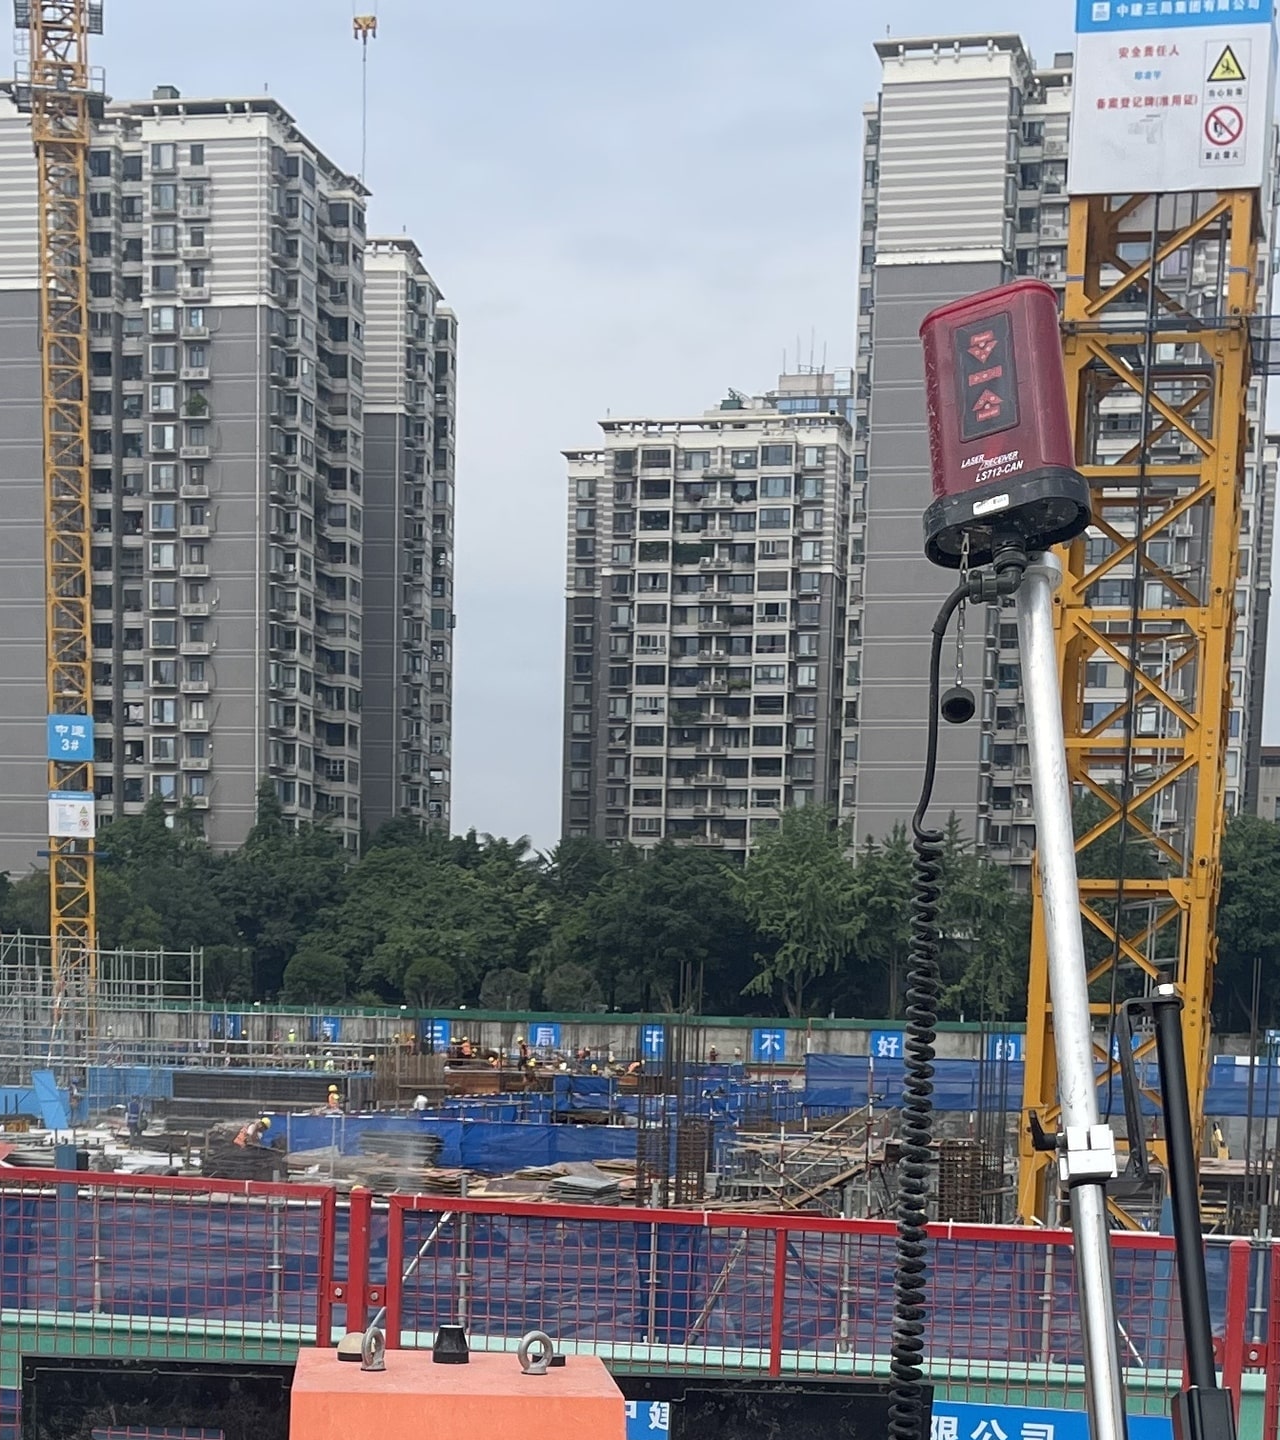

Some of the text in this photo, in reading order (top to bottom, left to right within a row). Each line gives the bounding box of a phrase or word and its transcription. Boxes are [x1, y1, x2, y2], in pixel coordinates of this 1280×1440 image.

[1119, 45, 1180, 58] 安全责任人
[961, 454, 985, 469] LASER
[984, 451, 1019, 468] RECEIVER
[975, 460, 1024, 482] LS712-CAN
[55, 724, 86, 737] 中建
[61, 739, 79, 751] 3#
[877, 1036, 900, 1058] 好
